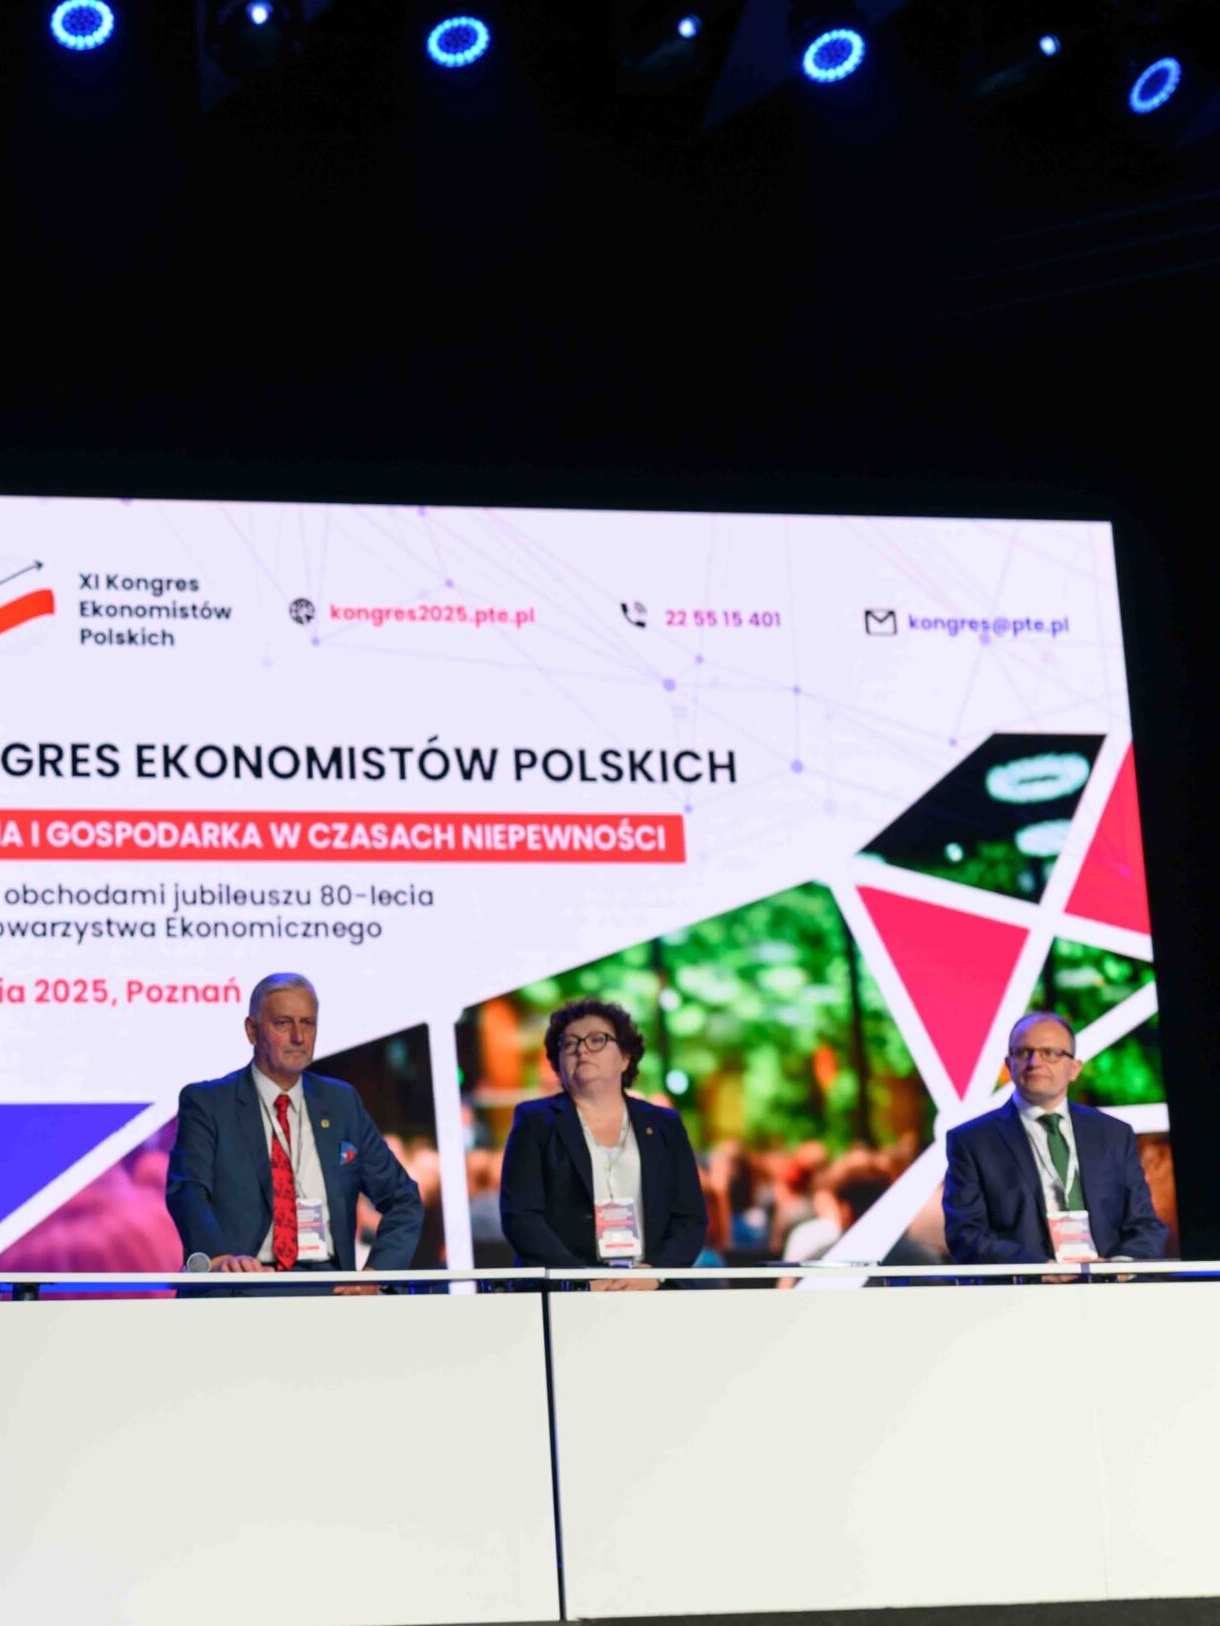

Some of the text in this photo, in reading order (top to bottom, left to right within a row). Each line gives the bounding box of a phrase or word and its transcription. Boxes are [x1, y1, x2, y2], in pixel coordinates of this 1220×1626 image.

[79, 573, 200, 593] XI Kongres
[79, 600, 232, 620] Ekonomistów
[330, 604, 535, 628] kongres2025.pte.pl
[666, 610, 781, 627] 22 55 15 401
[80, 628, 175, 646] Polskich
[908, 614, 1070, 638] kongres@pte.pl
[135, 735, 499, 782] EKONOMISTÓW
[513, 748, 737, 784] POLSKICH
[31, 821, 39, 847] I
[46, 820, 262, 849] GOSPODARKA
[270, 822, 301, 849] W
[308, 823, 455, 850] CZASACH
[462, 818, 665, 851] NIEPEWNOŚCI
[4, 883, 165, 906] obchodami
[173, 883, 311, 912] jubileuszu
[320, 884, 434, 906] 80-lecia
[166, 916, 382, 946] Ekonomicznego
[35, 978, 117, 1006] 2025,
[126, 976, 241, 1004] Poznań
